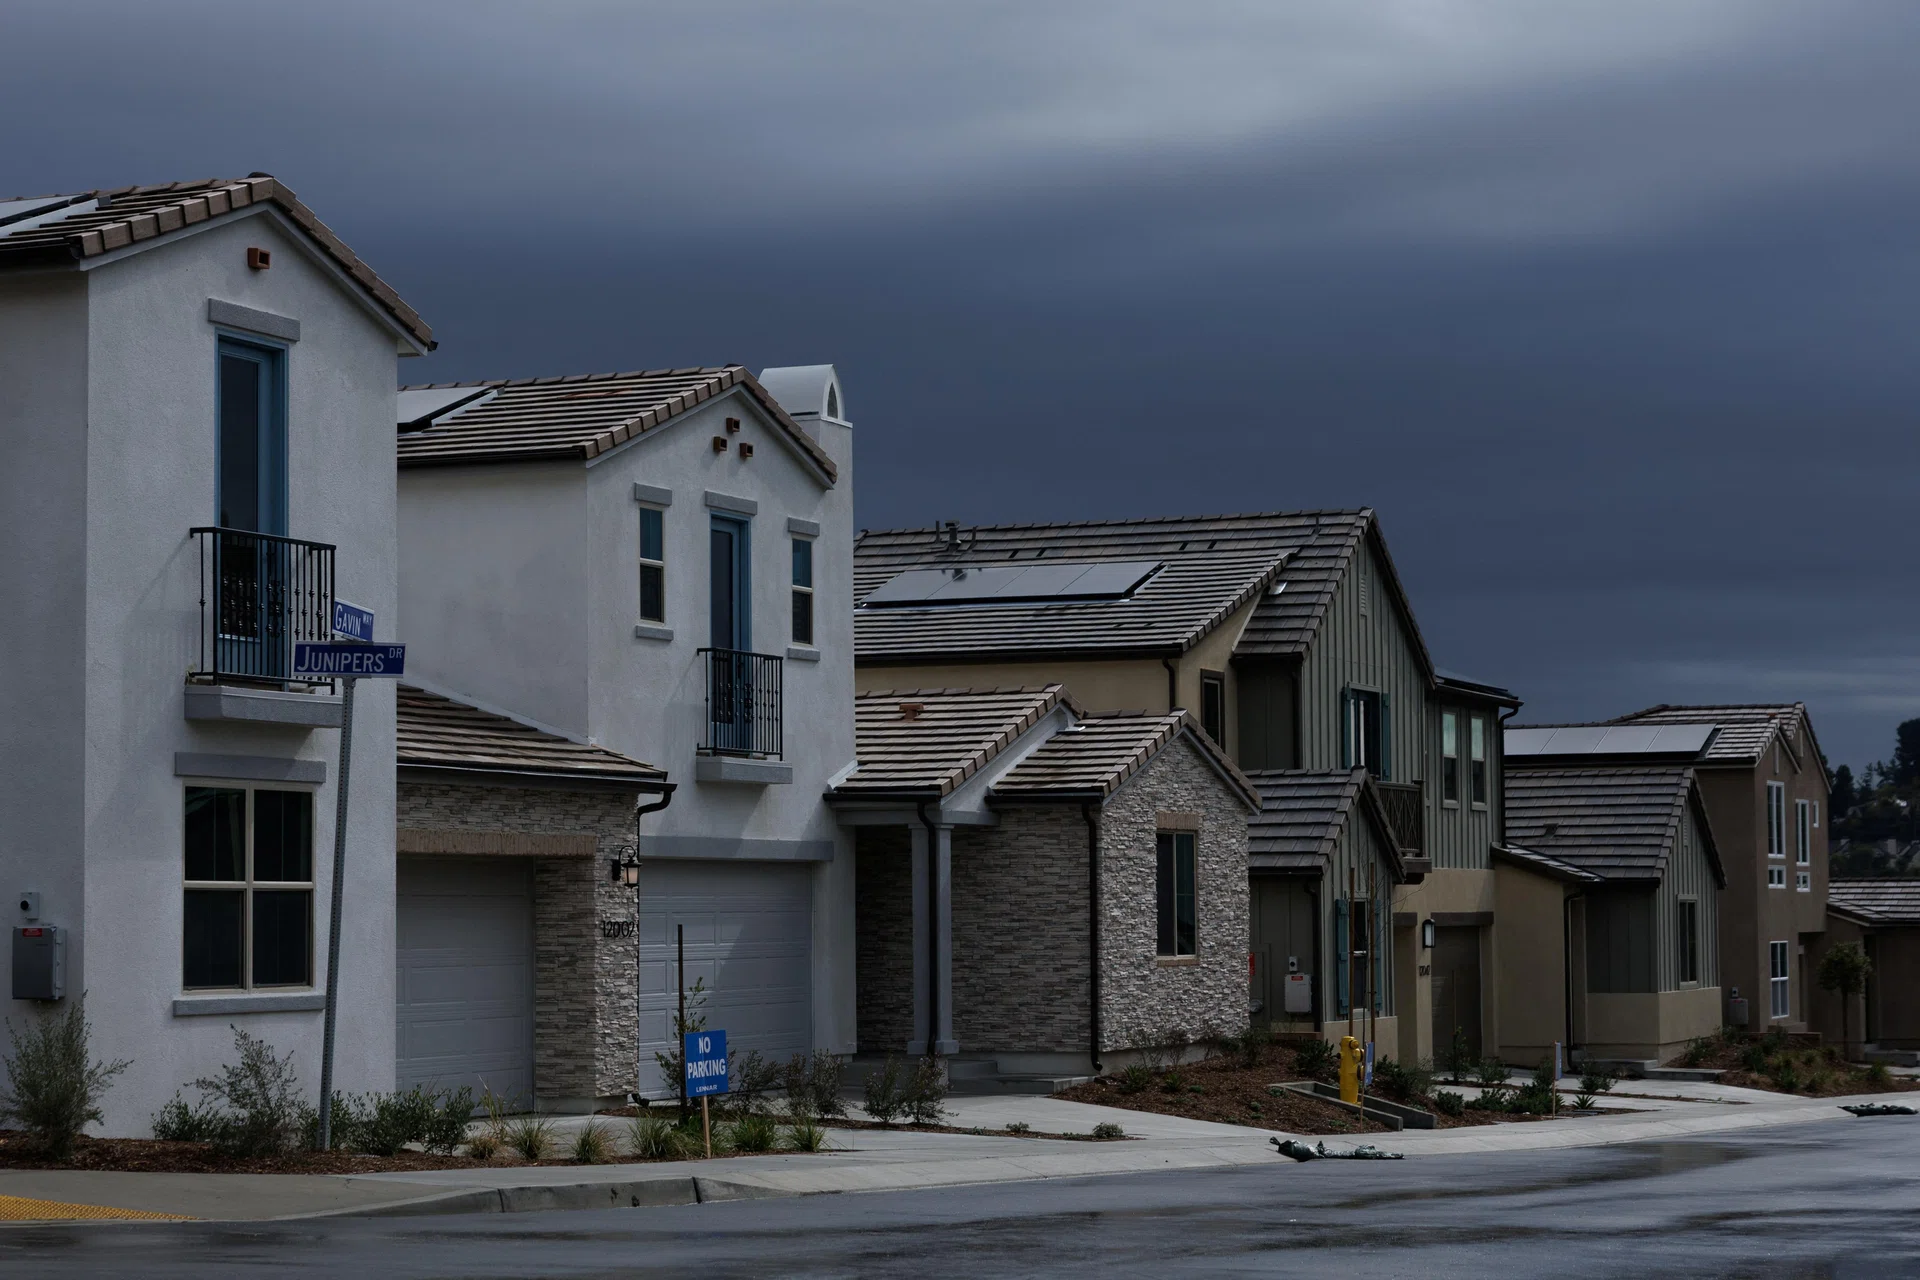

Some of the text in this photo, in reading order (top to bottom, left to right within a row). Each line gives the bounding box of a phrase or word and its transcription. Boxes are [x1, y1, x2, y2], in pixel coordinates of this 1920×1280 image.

[335, 604, 372, 636] GAVIN WAY
[297, 646, 403, 673] JUNIPERS DR
[601, 920, 635, 937] 12002
[698, 1036, 711, 1054] NO
[687, 1058, 726, 1079] PARKING
[695, 1084, 718, 1093] LENNAR
